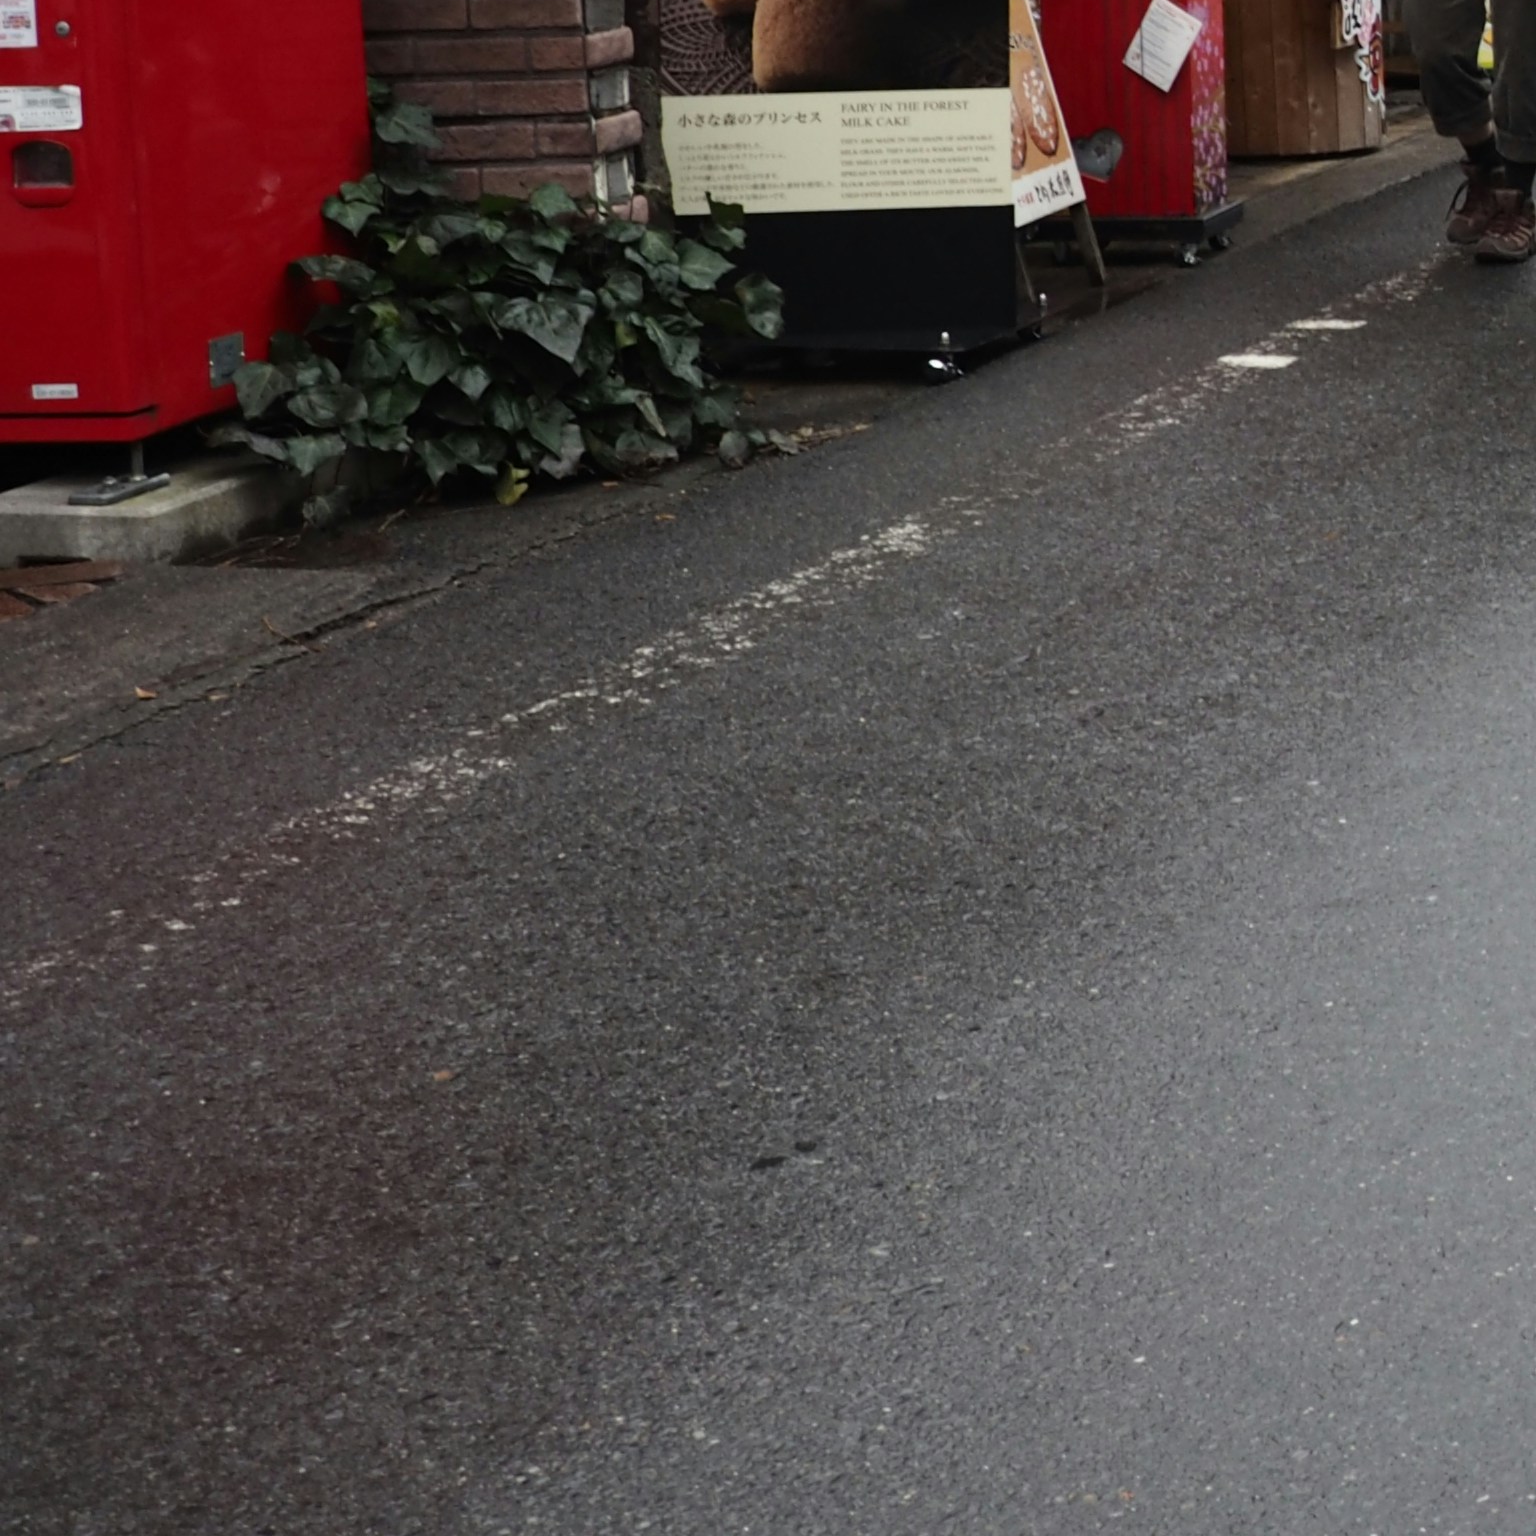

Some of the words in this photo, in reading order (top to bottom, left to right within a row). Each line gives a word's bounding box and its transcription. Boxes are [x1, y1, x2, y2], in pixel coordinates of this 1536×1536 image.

[841, 103, 876, 114] FAIRY
[880, 102, 893, 113] IN
[897, 101, 920, 112] THE
[923, 100, 969, 111] FOREST
[841, 117, 873, 128] MILK
[876, 116, 910, 127] CAKE
